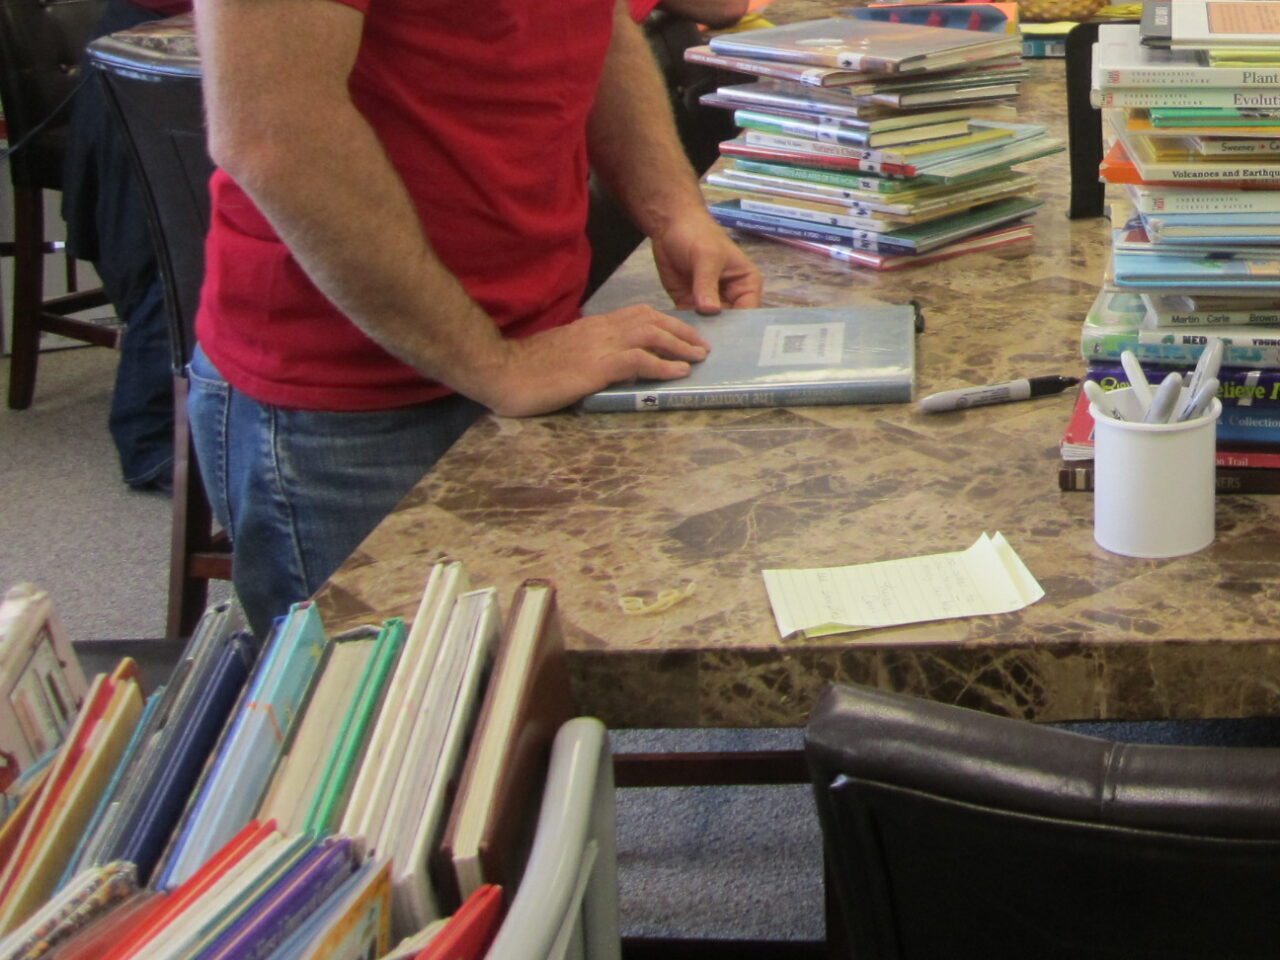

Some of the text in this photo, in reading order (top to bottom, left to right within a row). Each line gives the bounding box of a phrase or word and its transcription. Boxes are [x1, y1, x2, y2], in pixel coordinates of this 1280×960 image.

[1242, 71, 1280, 84] Plant
[1172, 170, 1219, 178] Volcanoes
[1222, 169, 1240, 177] and
[1171, 314, 1231, 323] Martin Carle
[1249, 313, 1278, 322] Brown
[1182, 335, 1208, 345] NED
[1216, 382, 1265, 398] elieve
[1228, 457, 1248, 466] Trail
